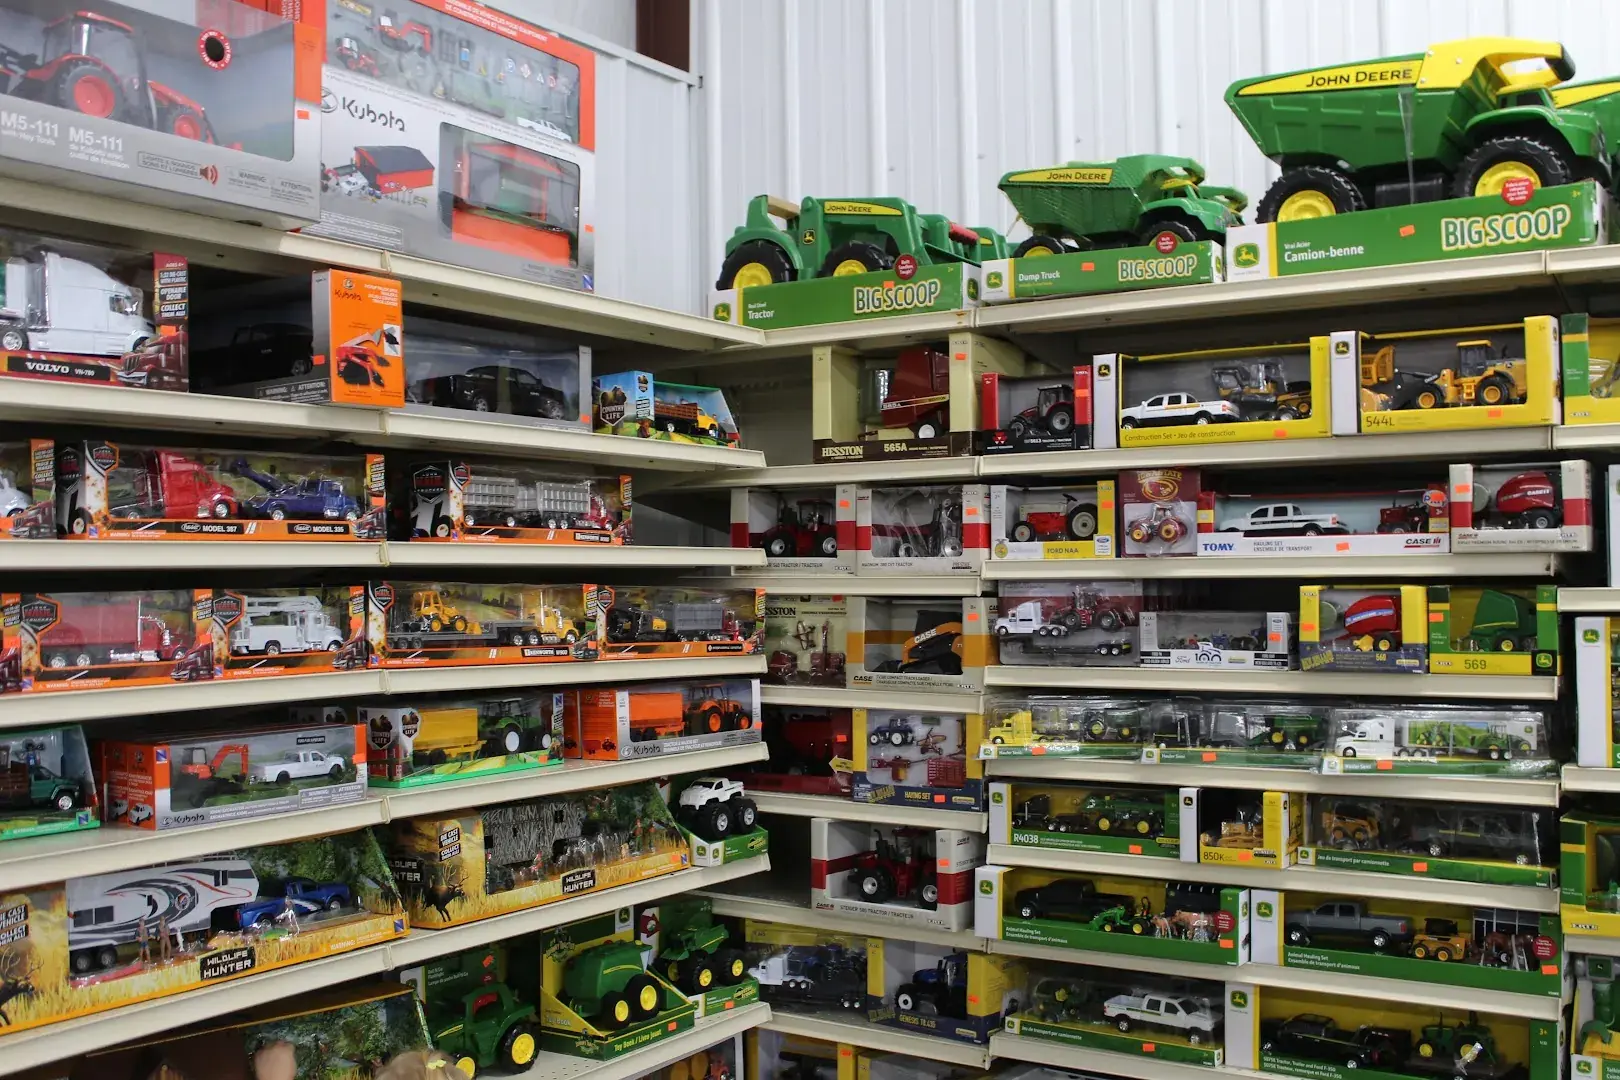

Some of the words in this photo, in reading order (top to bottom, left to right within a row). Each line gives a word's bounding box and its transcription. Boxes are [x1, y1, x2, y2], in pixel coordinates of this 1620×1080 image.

[1306, 74, 1350, 88] JOHN
[1355, 68, 1413, 84] DEERE
[342, 96, 406, 132] Kubota
[0, 110, 58, 138] M5-111
[69, 126, 122, 152] M5-111
[1047, 172, 1072, 180] JOHN
[1074, 172, 1106, 180] DEERE
[1284, 242, 1296, 250] Vrai
[1284, 244, 1365, 263] Camion-benne
[1018, 272, 1040, 282] Dump
[1040, 270, 1060, 280] Truck
[160, 287, 186, 295] OPENABLE
[160, 303, 186, 312] COLLECT
[748, 309, 776, 320] Tractor
[25, 361, 70, 374] VOLVO
[266, 386, 288, 396] WARNING:
[298, 382, 326, 391] ATTENTION:
[602, 404, 624, 412] COUNTRY
[606, 412, 620, 420] LIFE
[1366, 416, 1396, 428] 544L
[1124, 432, 1162, 442] Construction
[1163, 432, 1172, 440] Set
[1198, 430, 1236, 438] construction
[822, 446, 864, 457] HESSTON
[884, 443, 908, 452] 565A
[1202, 543, 1235, 552] TOMY
[764, 607, 796, 616] SSTON
[914, 628, 937, 644] CASE
[1464, 659, 1487, 670] 569
[634, 745, 661, 756] Kubota
[920, 792, 931, 800] SET
[174, 814, 204, 824] Kubota
[448, 830, 459, 840] CAST
[1014, 833, 1039, 844] R4038
[442, 836, 459, 846] VEHICLE
[440, 846, 460, 856] COLLECT
[1203, 852, 1225, 861] 850K
[1332, 855, 1352, 863] transport
[1360, 858, 1390, 867] camionnette
[392, 872, 420, 883] NTER
[566, 870, 592, 884] WILDLIFE
[564, 879, 594, 892] HUNTER
[8, 904, 26, 917] CAST
[0, 924, 26, 940] OLLECT
[1019, 928, 1034, 936] Hauling
[330, 939, 357, 950] WARNING:
[1030, 935, 1047, 943] transport
[1048, 936, 1068, 944] d'animaux
[206, 948, 248, 966] WILDLIFE
[1288, 951, 1304, 959] Animal
[1304, 952, 1322, 962] Hauling
[203, 959, 252, 978] HUNTER
[1288, 958, 1310, 966] Ensemble
[1318, 960, 1336, 970] transport
[1337, 962, 1360, 970] d'animaux
[899, 1014, 920, 1024] GENESIS
[1034, 1028, 1050, 1036] transport
[1058, 1032, 1082, 1040] camionnette
[1538, 1028, 1548, 1036] 3+
[614, 1042, 622, 1052] Toy
[624, 1039, 636, 1050] Book
[639, 1034, 650, 1044] Livre
[650, 1030, 662, 1041] jouet
[1276, 1058, 1292, 1066] Tractor,
[1294, 1068, 1314, 1076] remorque
